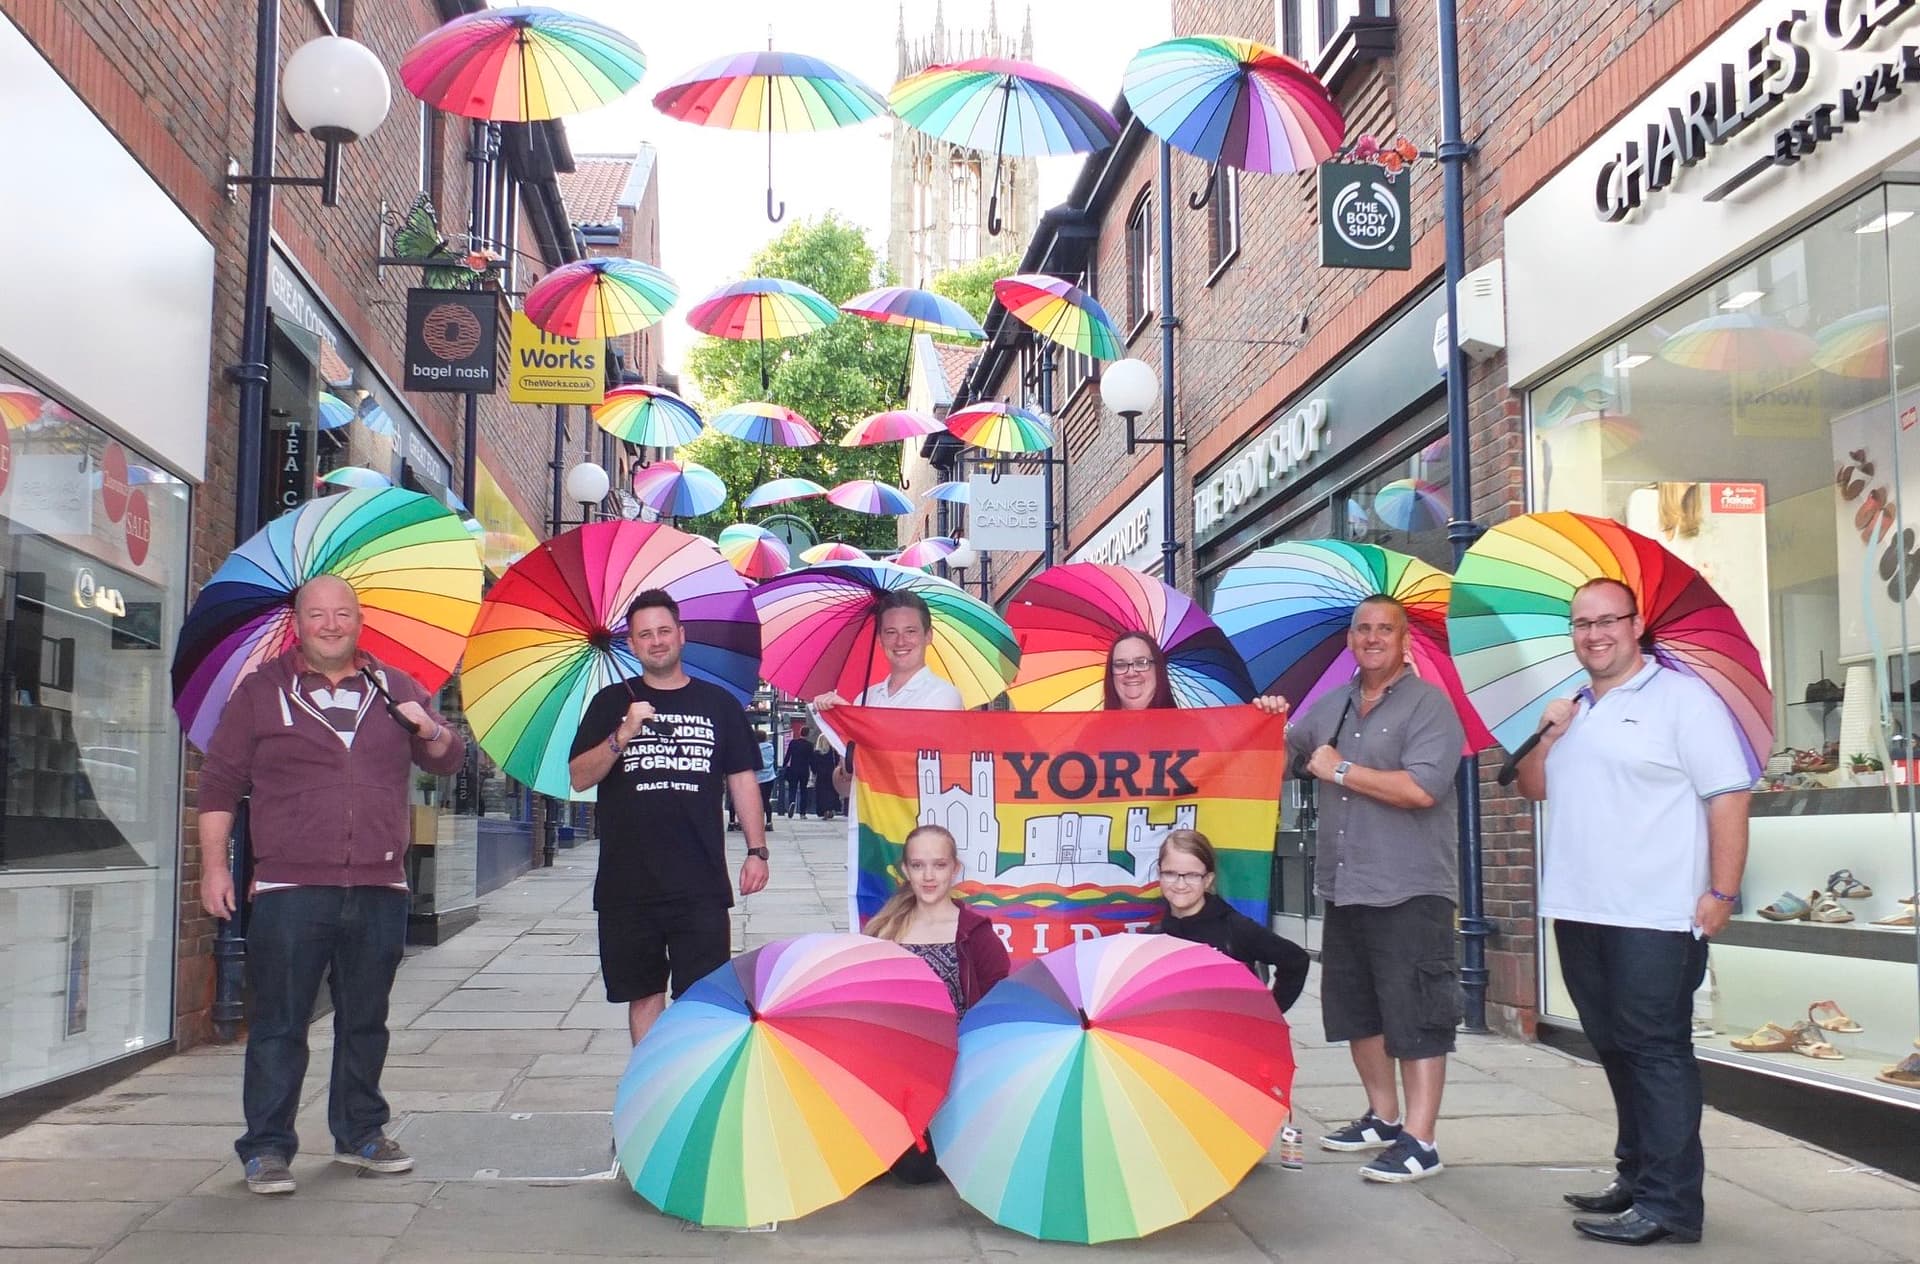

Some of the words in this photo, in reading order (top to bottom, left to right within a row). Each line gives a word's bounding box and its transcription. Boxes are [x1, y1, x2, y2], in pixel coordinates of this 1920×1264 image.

[1839, 46, 1917, 122] 1924
[1594, 10, 1810, 222] CHARLES
[1354, 201, 1379, 213] THE
[1346, 212, 1388, 226] BODY
[1348, 225, 1386, 238] SHOP
[271, 264, 305, 325] GREAT
[520, 348, 596, 370] Works
[412, 363, 452, 379] bagel
[455, 366, 489, 379] nash
[523, 379, 592, 389] TheWorks.co.uk
[283, 421, 301, 472] TEA
[1193, 478, 1224, 534] THE
[1224, 438, 1271, 514] BODY
[126, 511, 150, 542] SALE
[683, 715, 714, 728] WILL
[623, 744, 677, 757] NARROW
[681, 745, 714, 758] VIEW
[624, 761, 639, 773] OF
[640, 755, 712, 774] GENDER
[1002, 749, 1200, 800] YORK
[636, 781, 669, 791] GRACE
